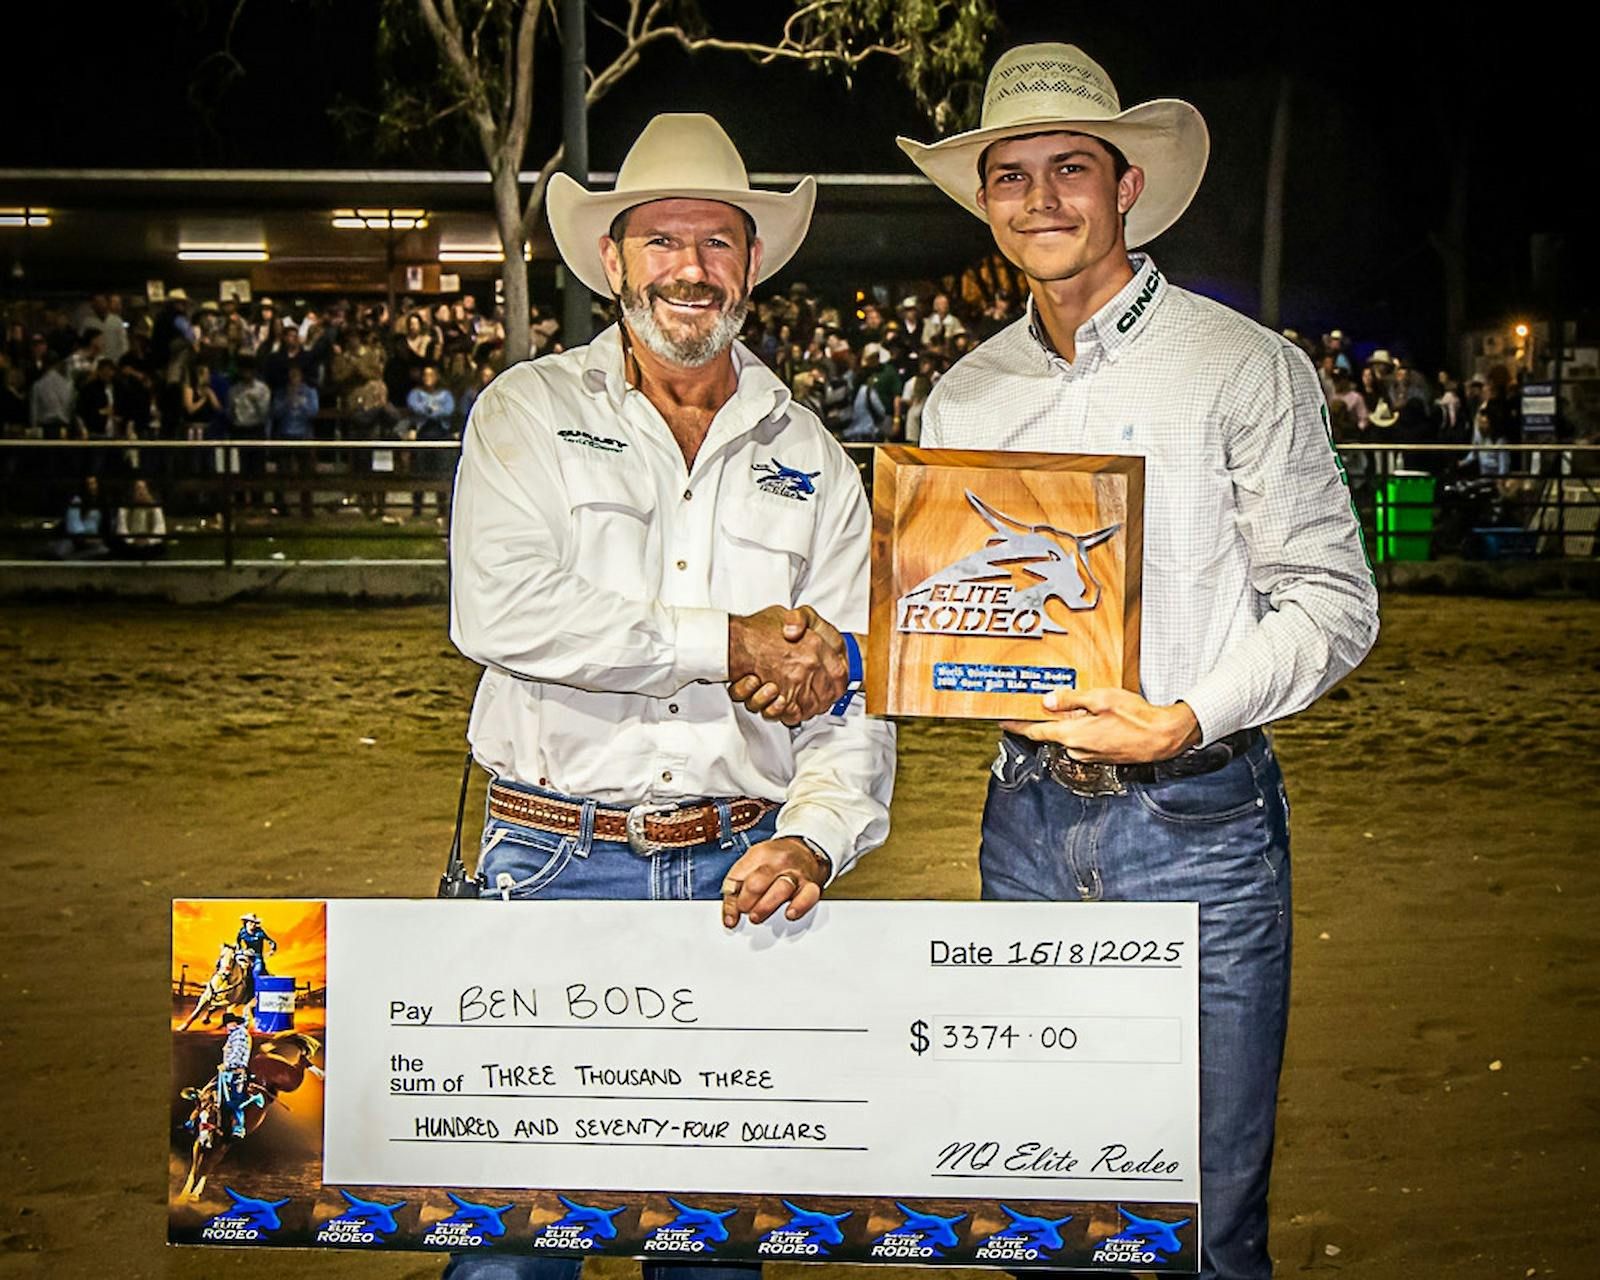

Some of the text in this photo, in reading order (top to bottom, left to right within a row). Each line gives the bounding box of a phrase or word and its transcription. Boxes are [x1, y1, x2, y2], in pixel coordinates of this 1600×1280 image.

[929, 583, 1013, 604] ELITE
[901, 605, 1041, 634] RODEO
[931, 941, 992, 964] Date
[459, 983, 698, 1023] BEN BODE
[390, 1002, 432, 1024] Pay
[910, 1019, 930, 1056] $
[390, 1054, 423, 1073] the
[390, 1075, 464, 1092] sum of
[482, 1064, 774, 1089] THREE THOUSAND THREE
[415, 1116, 827, 1141] HUNDRED AND SEVENTY-FOUR DOLLARS
[936, 1141, 1180, 1174] NQ Elite Rodeo
[203, 1230, 258, 1240] RODEO
[318, 1232, 374, 1243] RODEO
[424, 1235, 482, 1246] RODEO
[534, 1238, 592, 1249] RODEO
[644, 1241, 704, 1252] RODEO
[758, 1243, 818, 1255] RODEO
[871, 1247, 933, 1257] RODEO
[975, 1249, 1038, 1260] RODEO
[1092, 1251, 1156, 1263] RODEO
